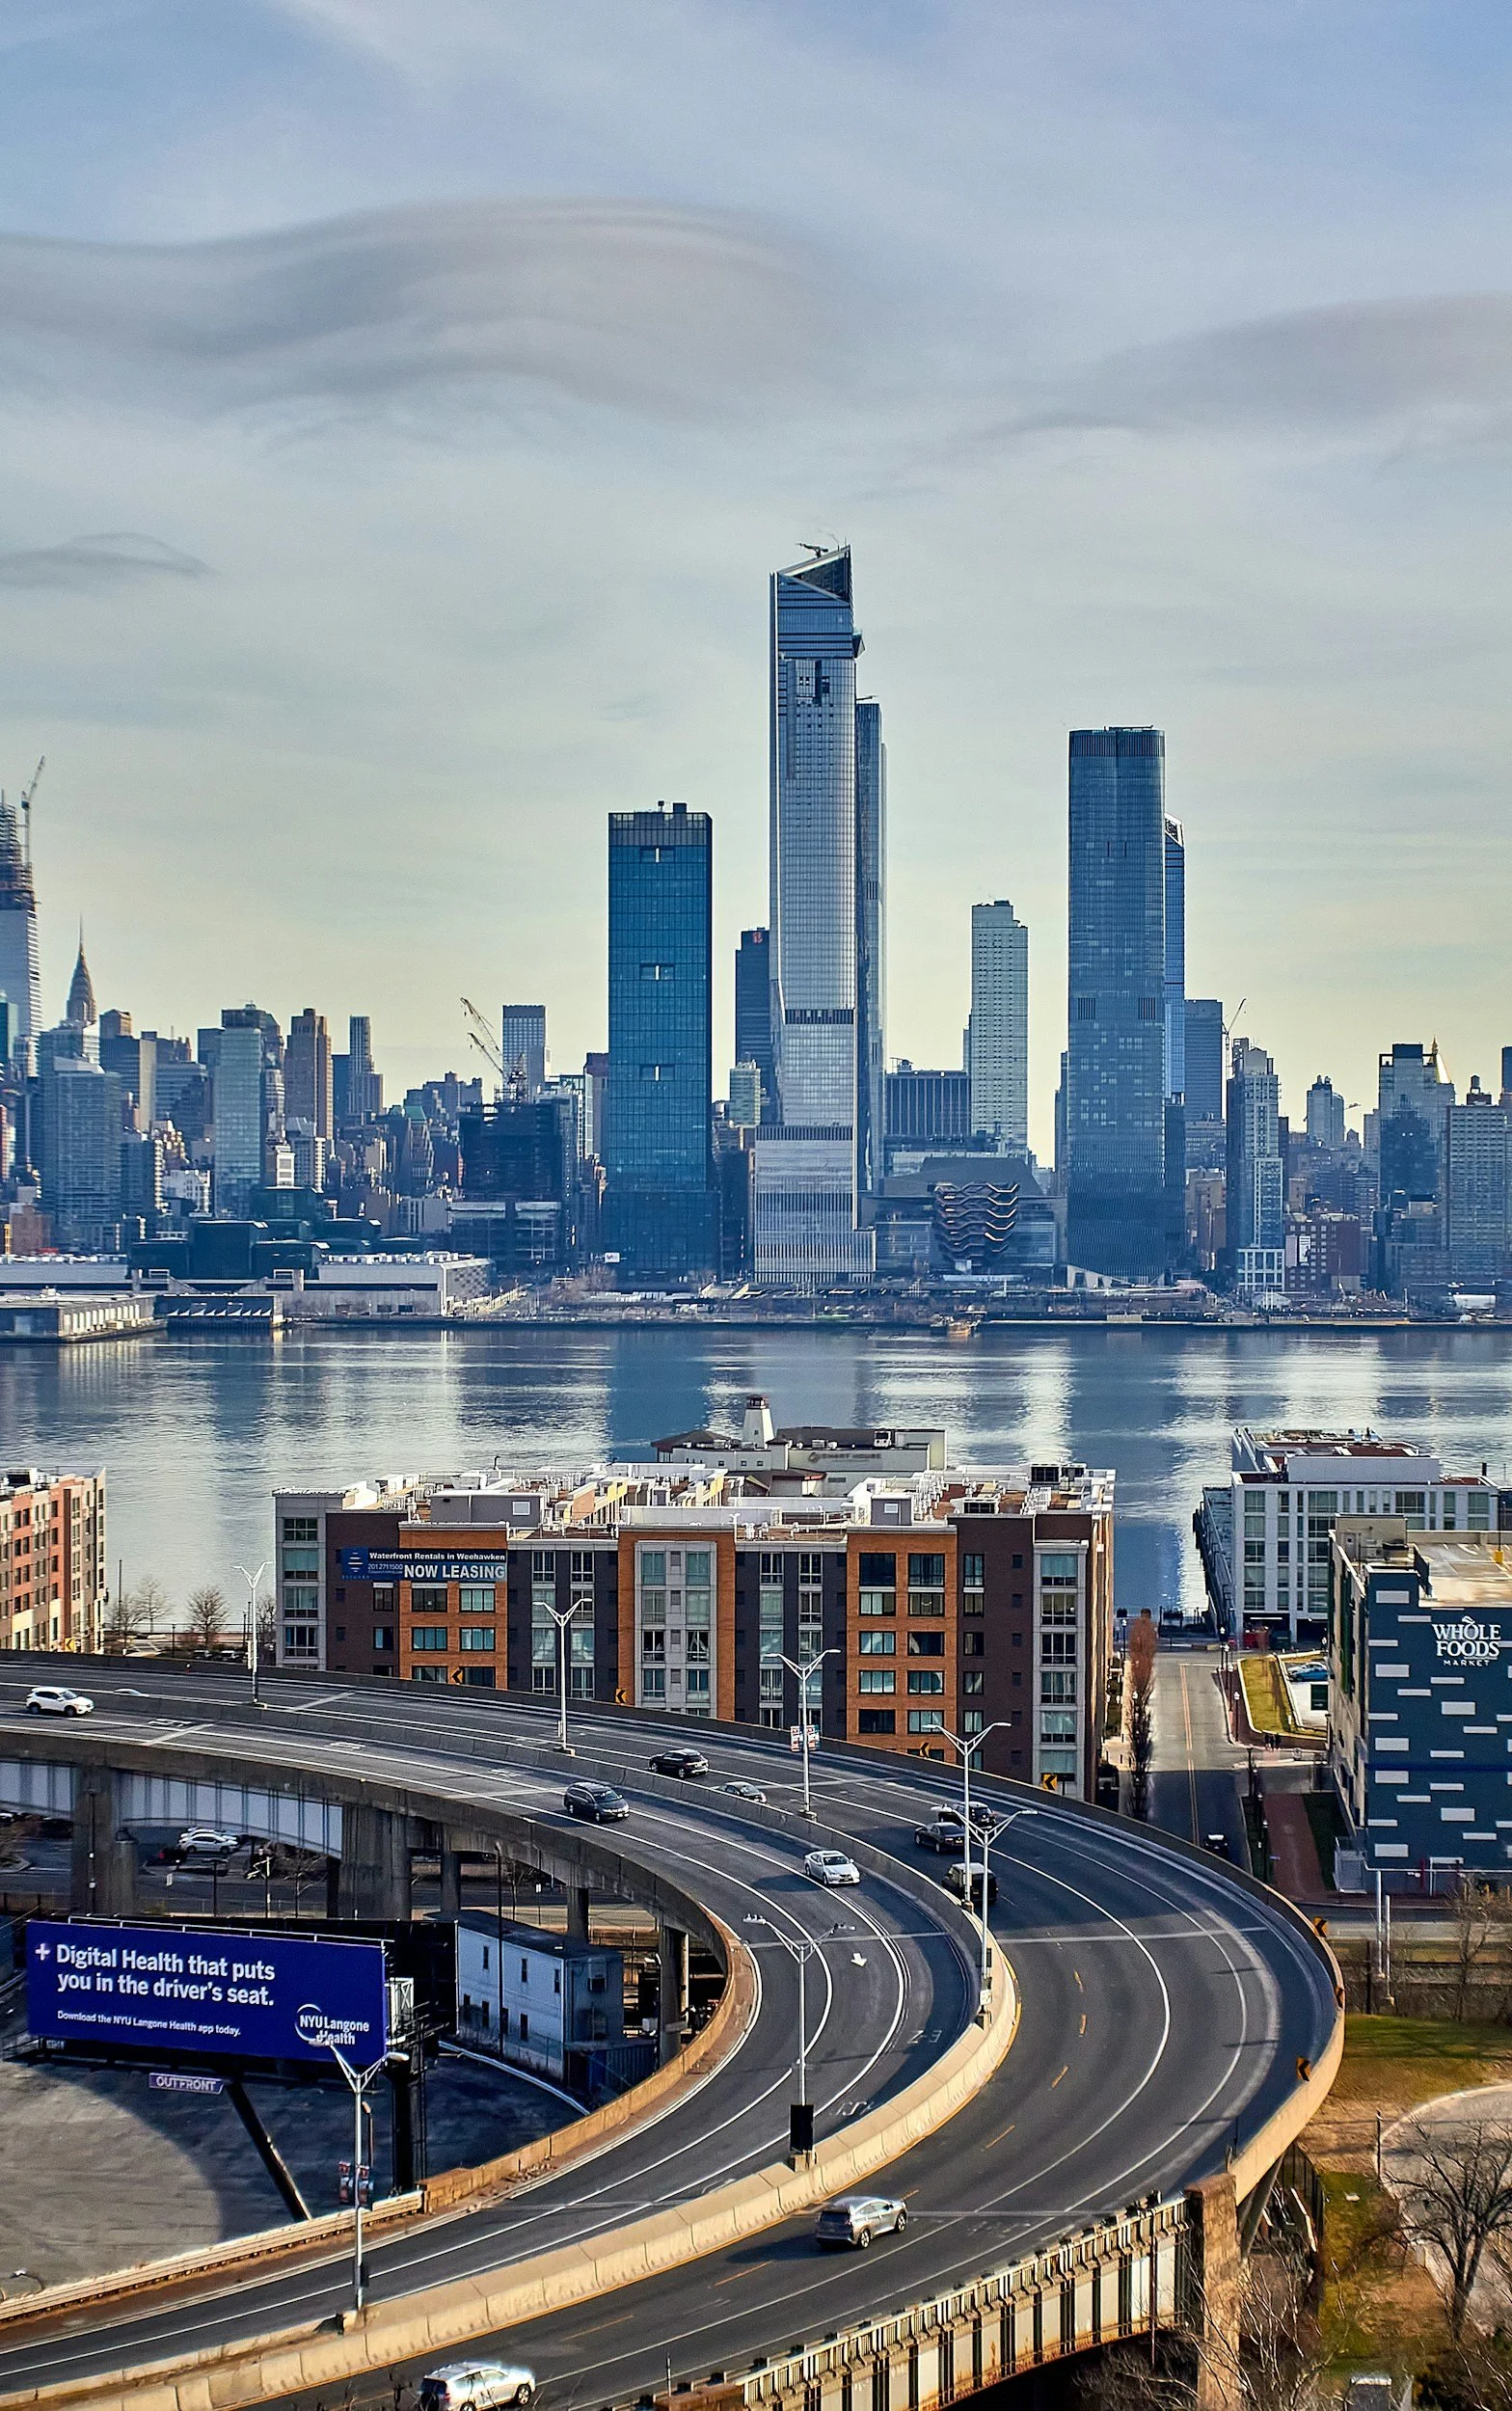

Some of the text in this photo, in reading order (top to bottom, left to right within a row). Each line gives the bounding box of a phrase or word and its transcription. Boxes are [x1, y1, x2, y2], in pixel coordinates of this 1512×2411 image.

[404, 1564, 505, 1579] NOW LEASING
[1431, 1622, 1501, 1639] WHOLE
[1435, 1640, 1499, 1657] FOODS
[57, 1944, 275, 1982] Digital Health that puts
[57, 1972, 274, 2006] you in the driver's seat.
[58, 2010, 241, 2037] Download the NYU Langone Health app today.
[300, 2015, 370, 2032] NYU Langone
[319, 2030, 356, 2045] Health
[155, 2075, 216, 2091] OUTFRONT
